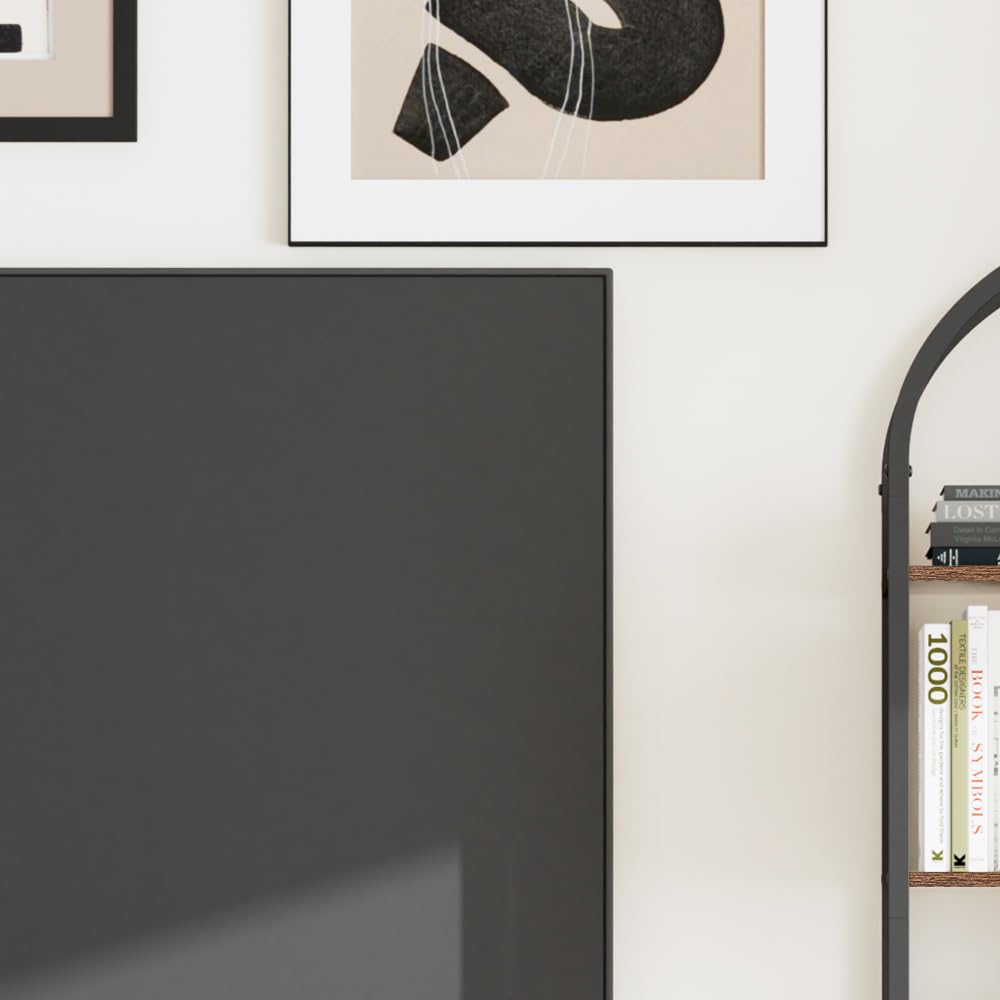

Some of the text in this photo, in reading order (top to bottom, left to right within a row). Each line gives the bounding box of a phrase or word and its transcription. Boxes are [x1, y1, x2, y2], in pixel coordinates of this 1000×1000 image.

[944, 503, 999, 520] LOST
[927, 633, 948, 705] 1000
[971, 670, 984, 720] BOOK
[971, 742, 984, 836] SYMBOLS
